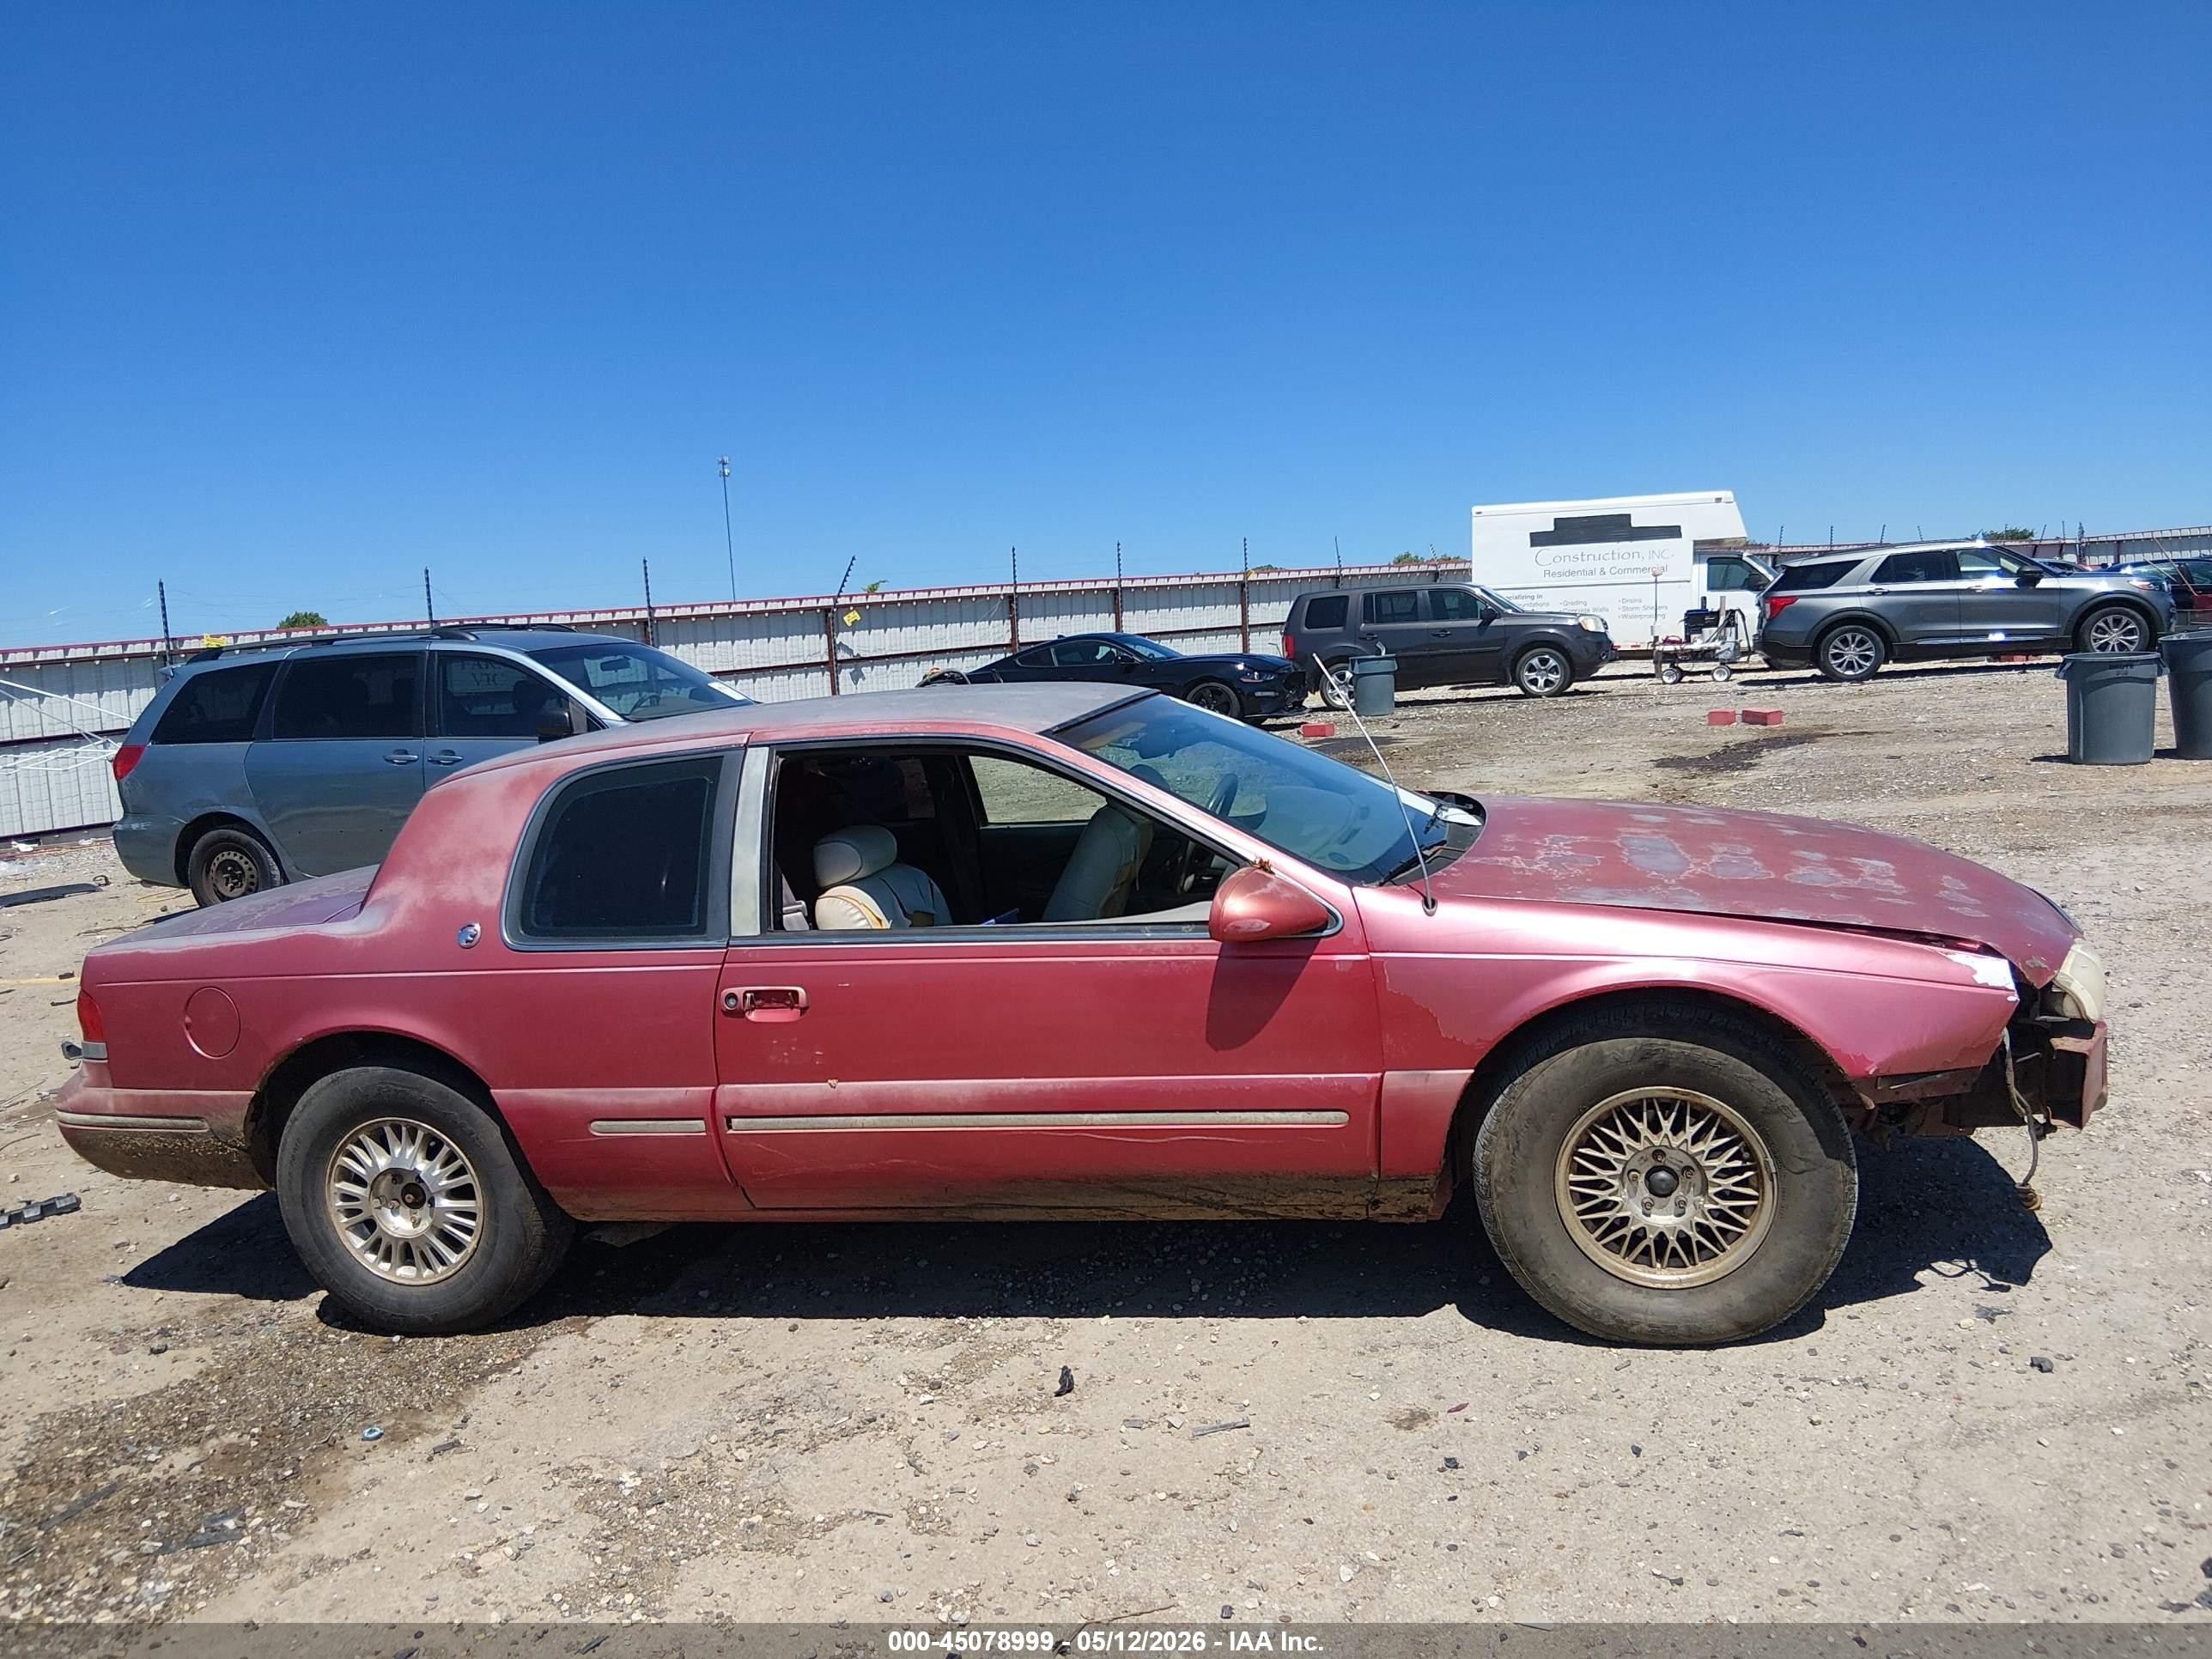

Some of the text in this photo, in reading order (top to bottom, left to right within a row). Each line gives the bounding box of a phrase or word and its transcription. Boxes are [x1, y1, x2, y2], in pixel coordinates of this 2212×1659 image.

[1534, 549, 1674, 567] Construction, INC.
[1543, 568, 1596, 578] Residential
[1599, 568, 1607, 576] &
